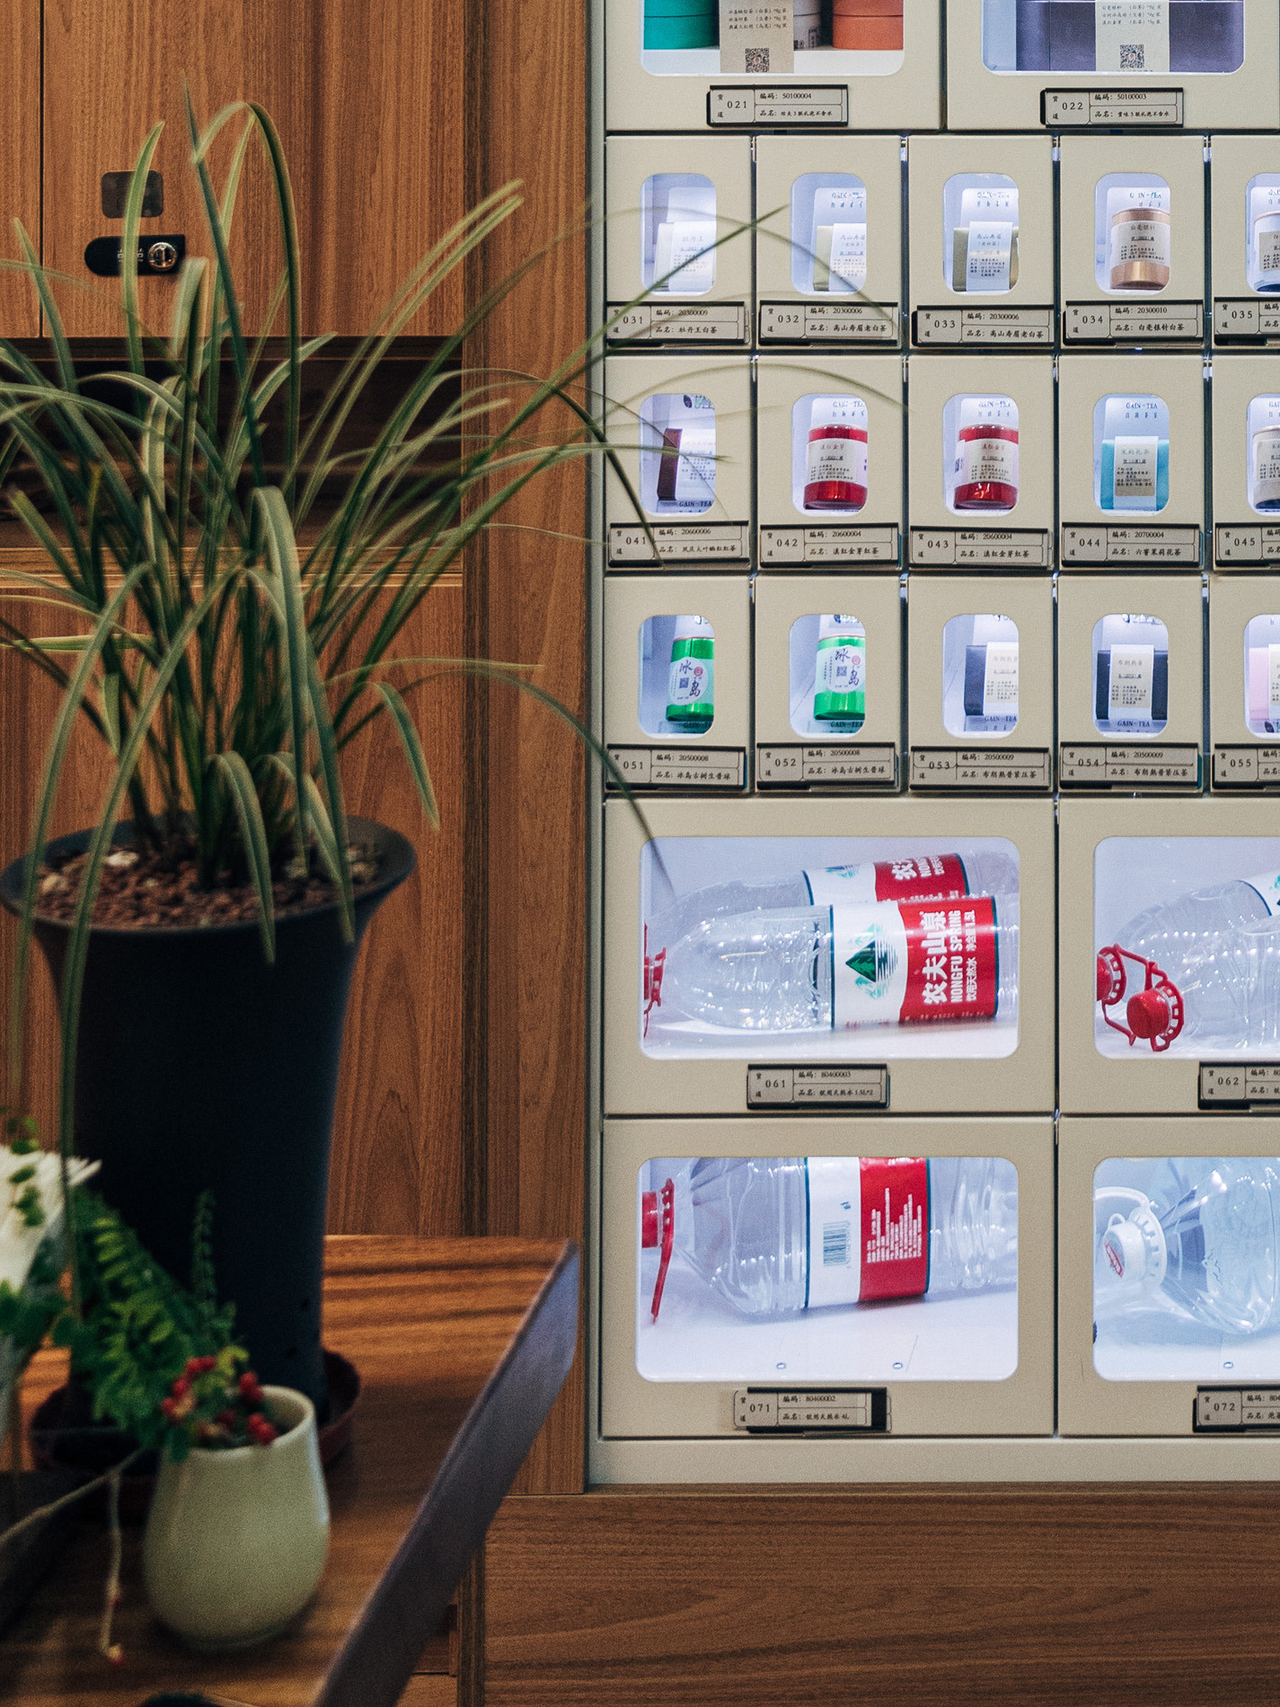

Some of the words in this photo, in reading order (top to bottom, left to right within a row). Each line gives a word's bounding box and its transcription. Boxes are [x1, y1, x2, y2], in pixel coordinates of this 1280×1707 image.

[727, 100, 748, 109] 021
[1061, 102, 1083, 111] 022
[777, 314, 800, 324] 032
[1082, 315, 1104, 324] 034
[1231, 310, 1254, 319] 035
[622, 315, 644, 325] 031
[934, 319, 956, 329] 033
[625, 536, 647, 545] 041
[776, 538, 799, 547] 042
[927, 539, 949, 549] 043
[1079, 538, 1101, 547] 044
[1234, 537, 1256, 547] 045
[623, 760, 644, 770] 051
[774, 758, 797, 767] 052
[1230, 758, 1252, 768] 055
[949, 909, 962, 950] SPRING
[922, 910, 948, 1005] 农夫山泉
[950, 952, 963, 1003] NONGFU
[765, 1079, 786, 1088] 061
[1217, 1077, 1239, 1086] 062
[749, 1403, 771, 1413] 071
[1213, 1402, 1235, 1412] 072
